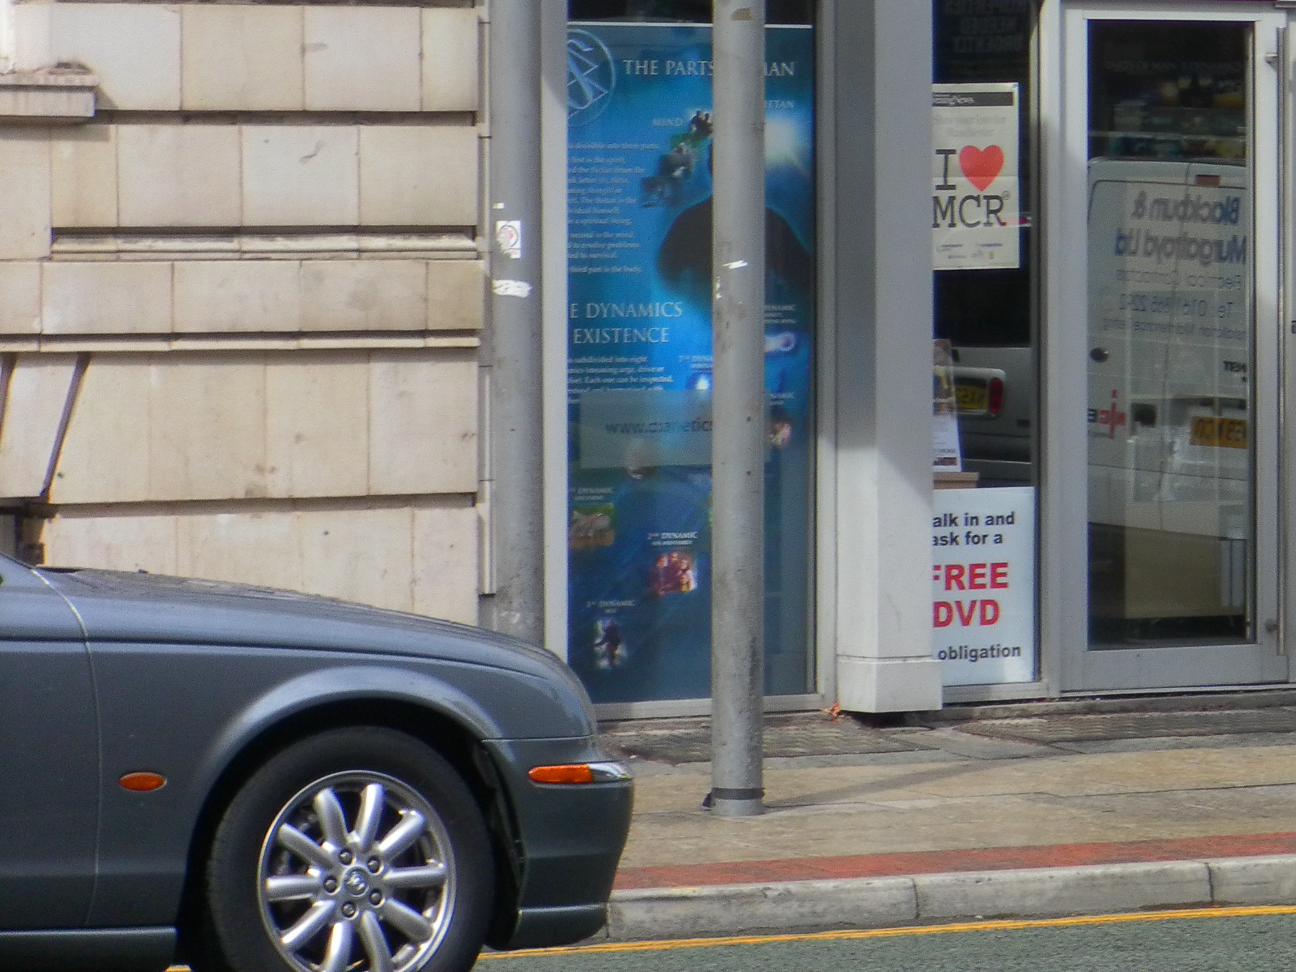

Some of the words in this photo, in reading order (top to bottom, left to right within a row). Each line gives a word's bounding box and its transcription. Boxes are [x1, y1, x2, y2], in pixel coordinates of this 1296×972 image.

[623, 59, 658, 76] THE
[935, 148, 957, 190] I
[932, 194, 1006, 228] MCR
[586, 301, 682, 319] DYNAMICS
[573, 327, 670, 344] EXISTENCE
[933, 512, 958, 528] alk
[964, 512, 979, 527] in
[985, 510, 1015, 526] and
[965, 531, 988, 546] for
[994, 534, 1003, 545] a
[933, 599, 1000, 628] DVD
[938, 644, 1021, 662] obligation
